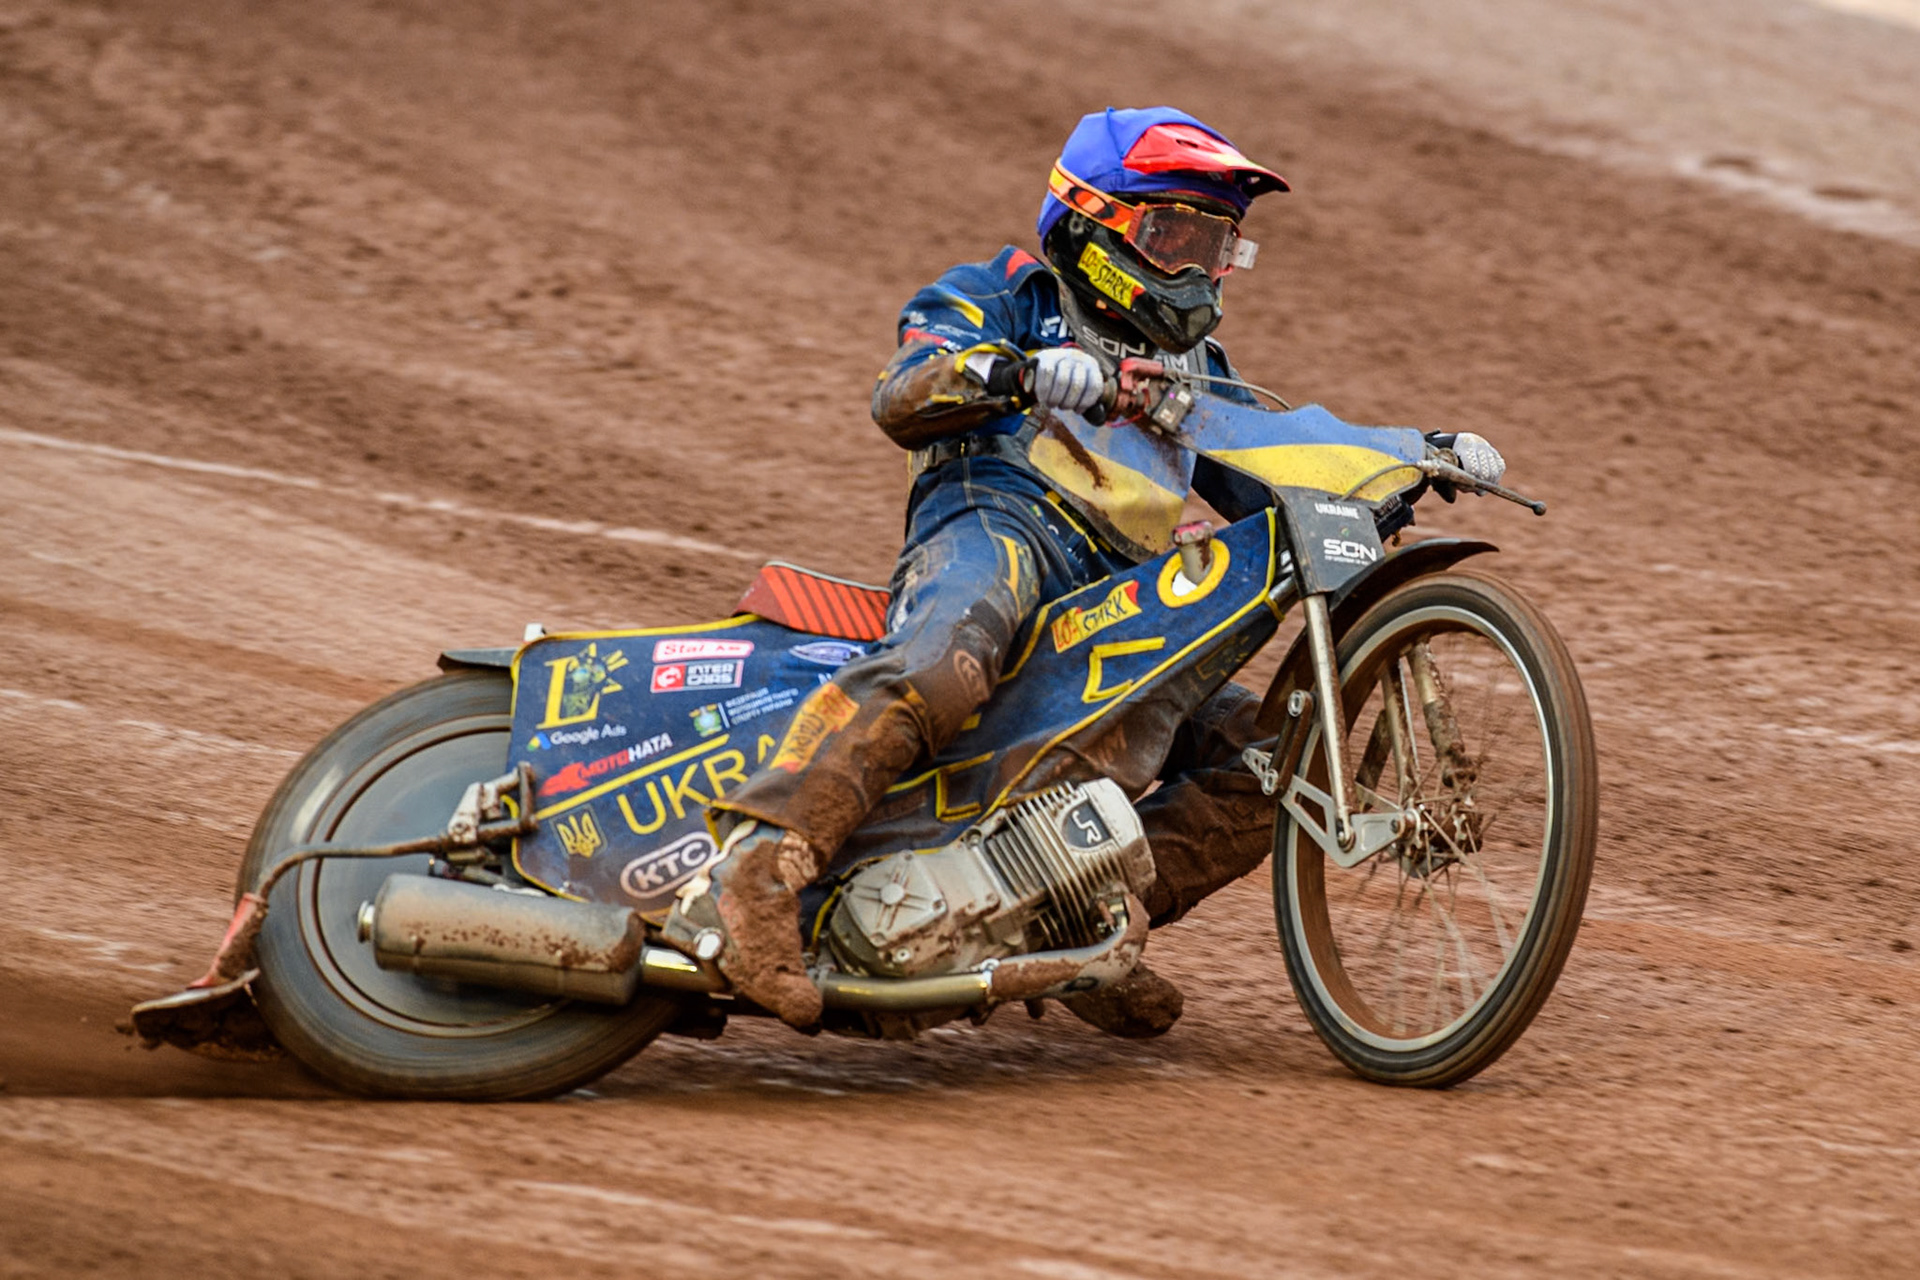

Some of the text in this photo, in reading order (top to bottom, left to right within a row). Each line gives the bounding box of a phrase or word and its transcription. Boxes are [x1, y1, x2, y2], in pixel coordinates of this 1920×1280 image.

[1040, 315, 1073, 338] FI
[1314, 503, 1360, 520] UKRAINE
[687, 664, 735, 676] INTER
[686, 674, 733, 686] CARS
[550, 724, 627, 745] Google Ads
[616, 735, 776, 835] UKR
